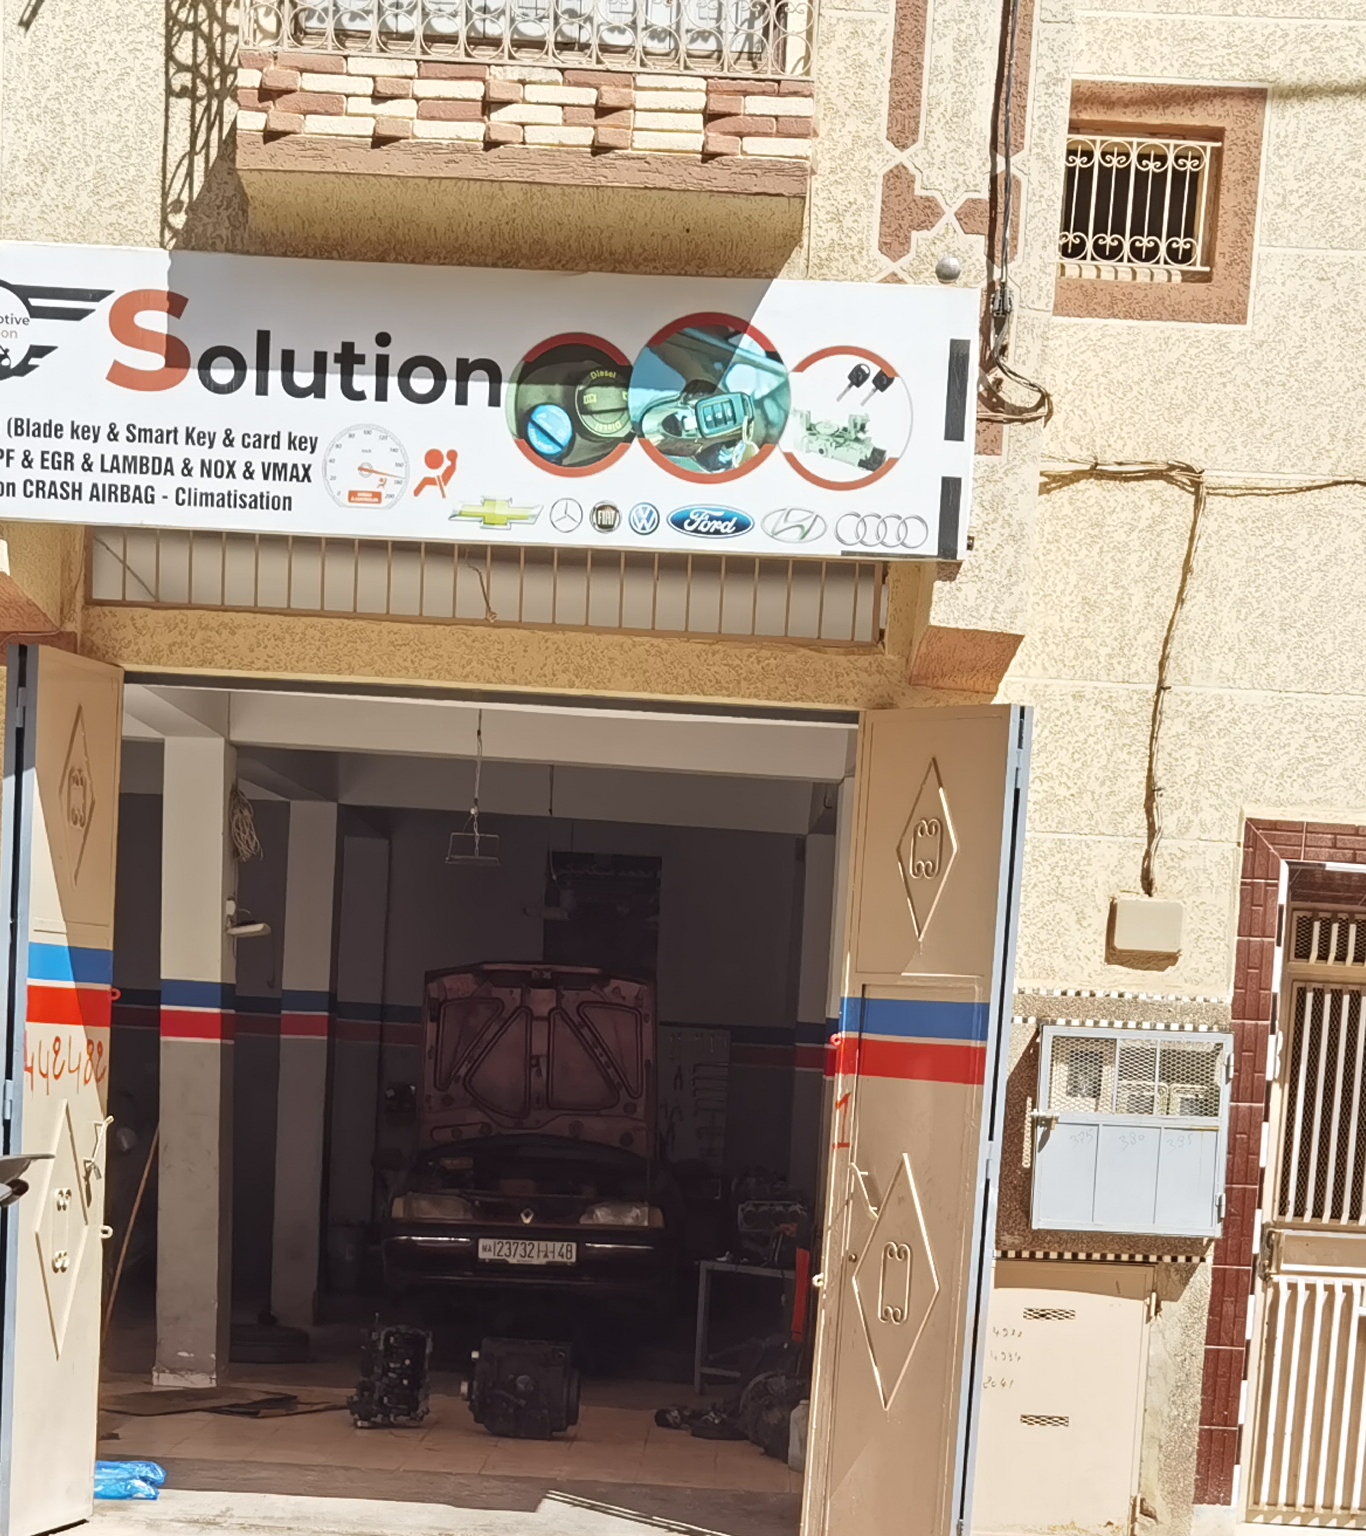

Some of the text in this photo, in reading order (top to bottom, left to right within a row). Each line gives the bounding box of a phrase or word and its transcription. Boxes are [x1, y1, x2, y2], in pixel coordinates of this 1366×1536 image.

[104, 287, 505, 408] Solution
[590, 369, 617, 380] Diesel
[7, 417, 64, 439] (Blade
[70, 420, 101, 444] key
[106, 422, 119, 442] &
[125, 423, 179, 446] Smart
[184, 426, 217, 450] Key
[222, 428, 235, 448] &
[241, 430, 281, 450] card
[287, 431, 319, 454] key
[21, 449, 34, 469] &
[40, 450, 75, 471] EGR
[81, 452, 94, 472] &
[100, 452, 175, 477] LAMBDA
[181, 457, 194, 478] &
[200, 458, 237, 479] NOX
[242, 460, 255, 480] &
[261, 461, 312, 483] VMAX
[22, 478, 83, 501] CRASH
[88, 482, 156, 505] AIRBAG
[175, 486, 292, 512] Climatisation
[683, 508, 736, 534] Ford
[496, 1241, 535, 1259] 23732
